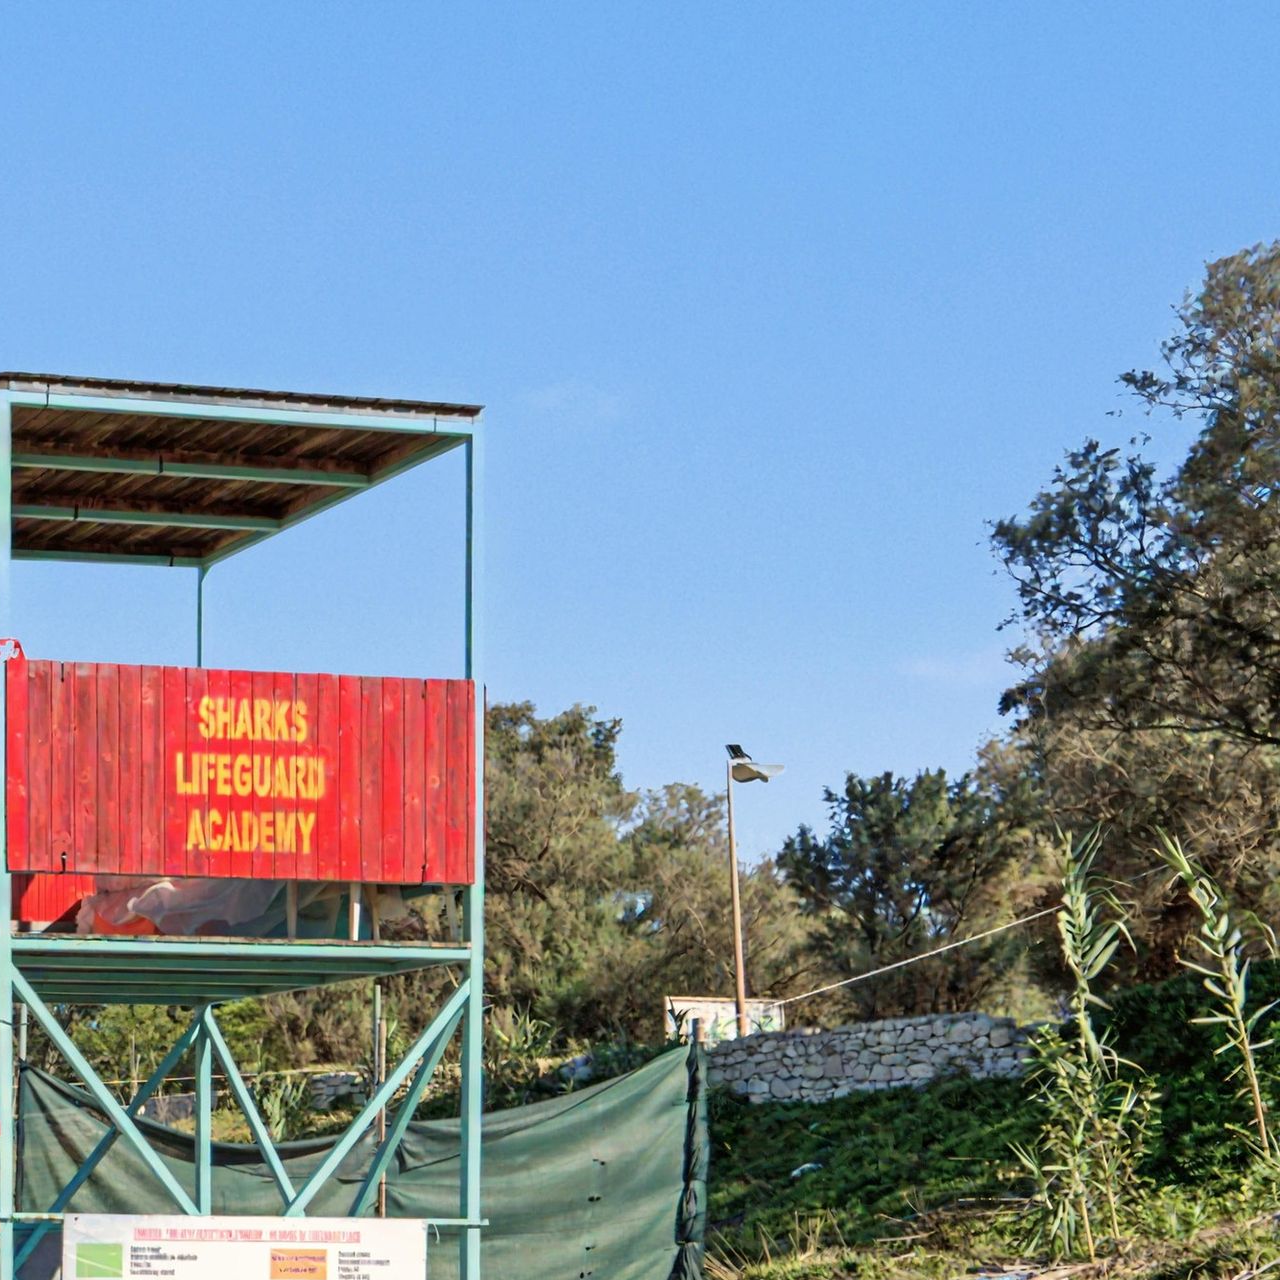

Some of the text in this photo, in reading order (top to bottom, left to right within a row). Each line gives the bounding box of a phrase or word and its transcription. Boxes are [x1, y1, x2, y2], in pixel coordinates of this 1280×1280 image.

[199, 696, 308, 742] SHARKS
[176, 751, 326, 800] LIFEGUARD
[186, 808, 316, 855] ACADEMY
